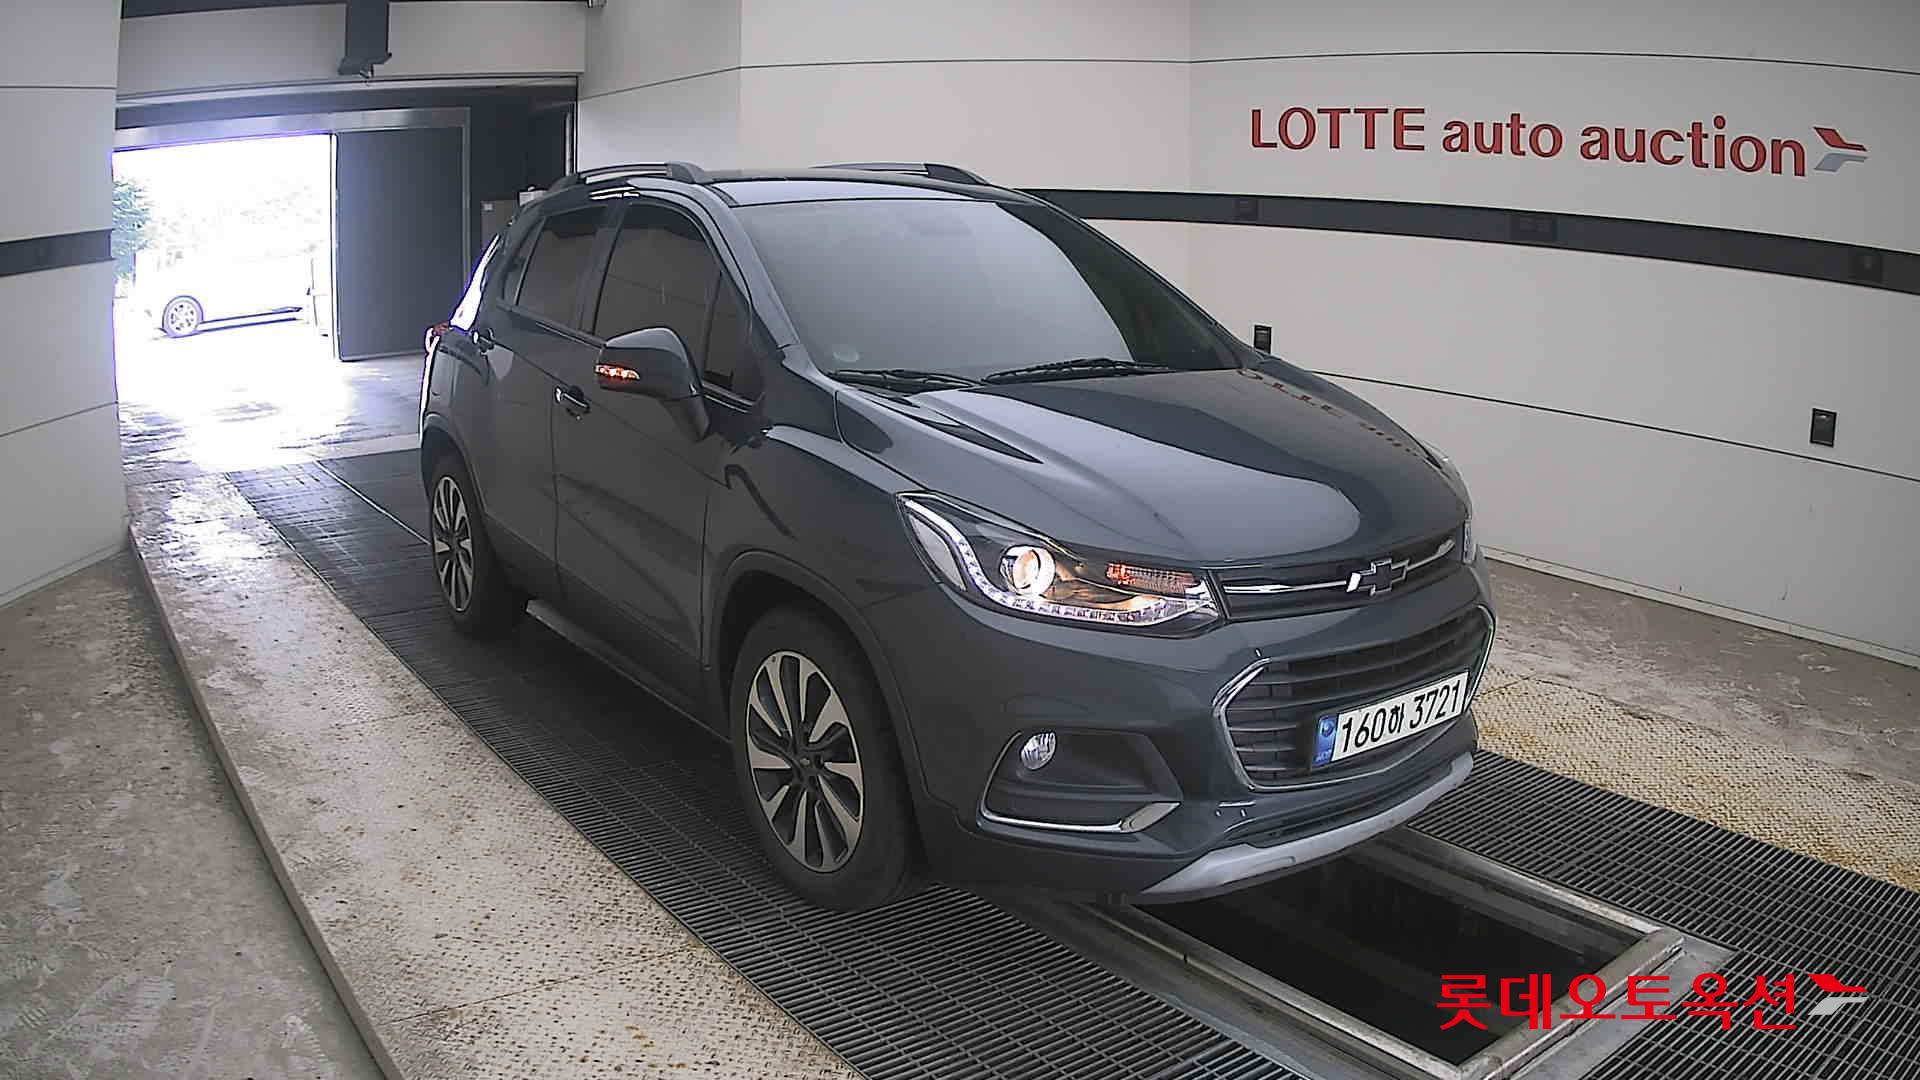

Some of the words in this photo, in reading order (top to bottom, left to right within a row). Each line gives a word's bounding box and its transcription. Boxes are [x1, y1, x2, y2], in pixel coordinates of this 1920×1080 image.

[1251, 107, 1426, 150] LOTTE
[1443, 113, 1564, 158] auto
[1580, 116, 1807, 176] auction
[1342, 703, 1405, 753] 160하
[1409, 679, 1461, 729] 3721
